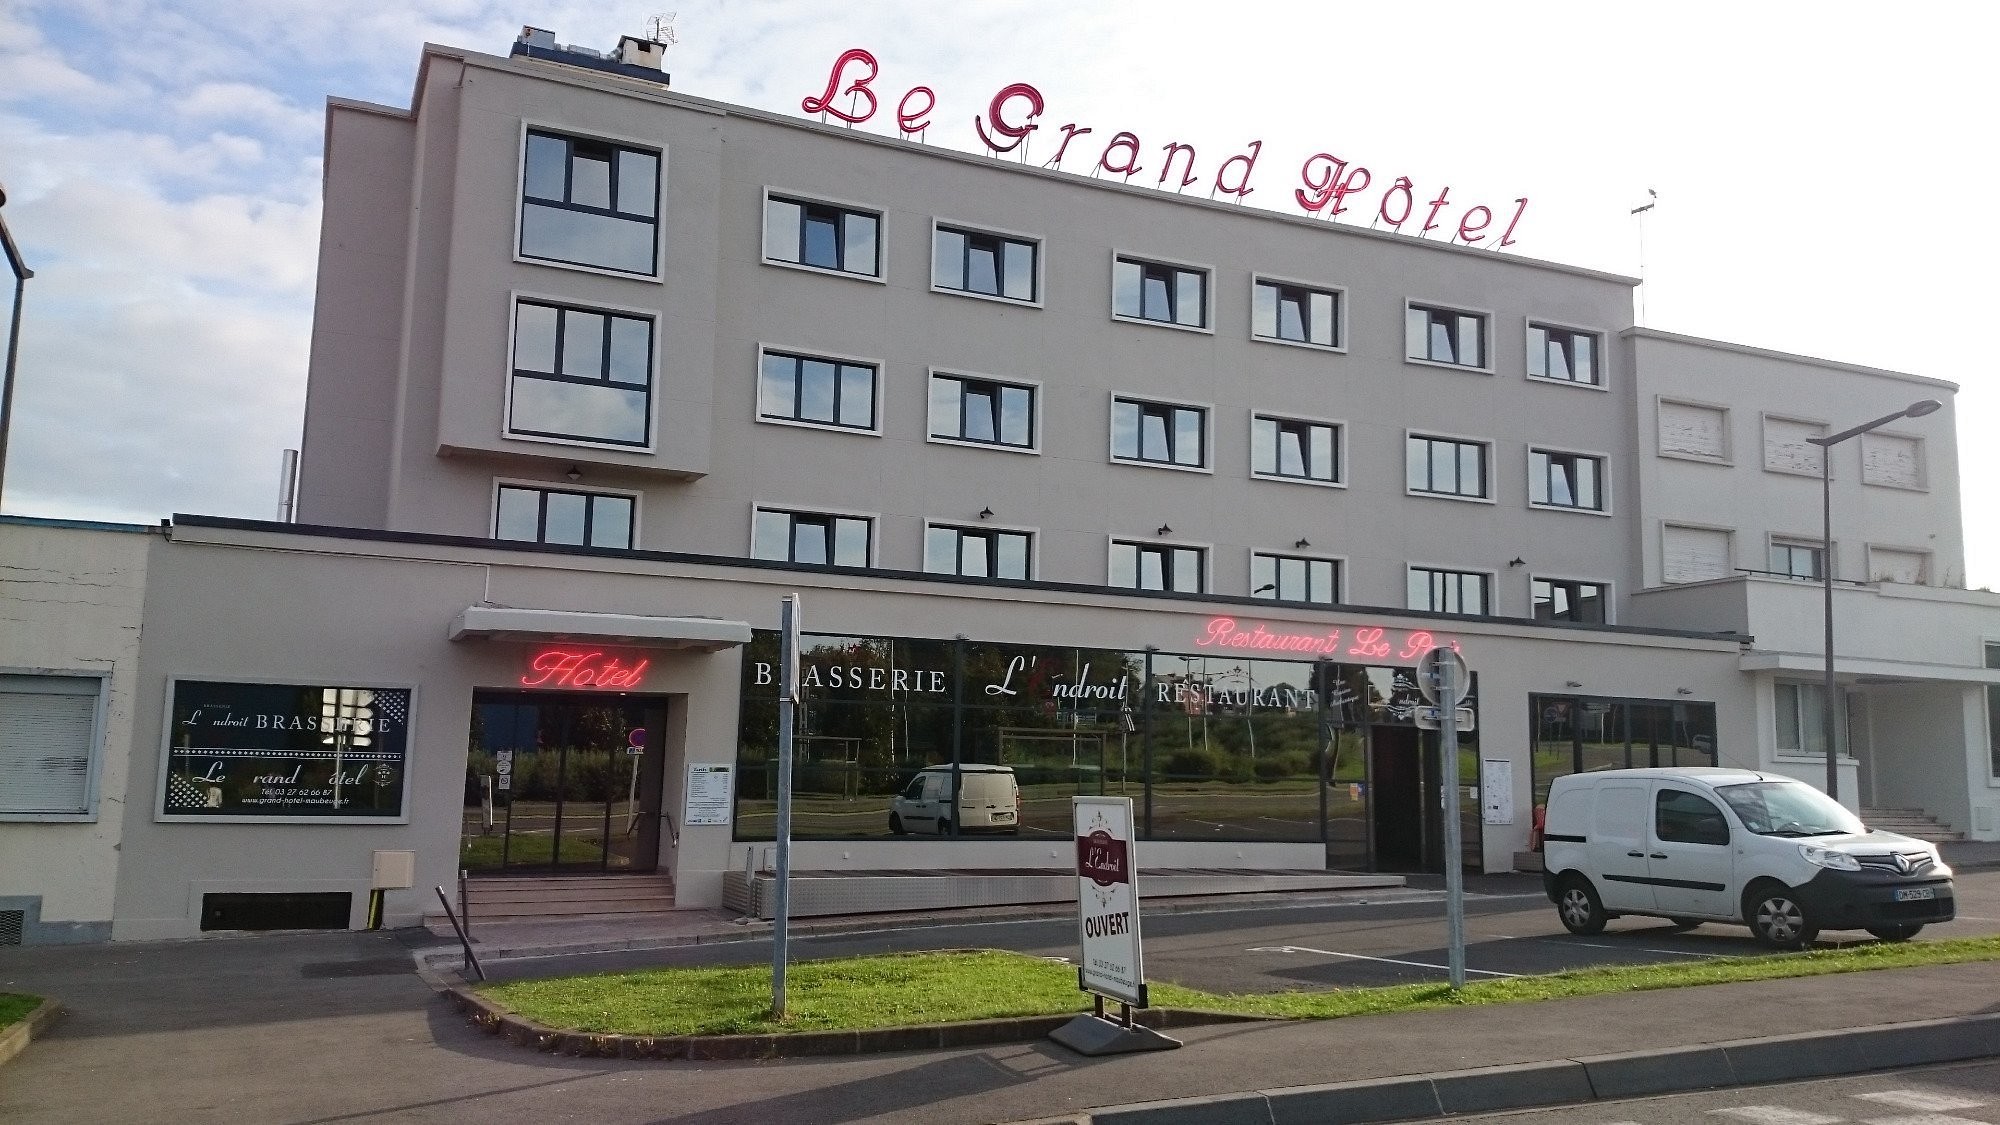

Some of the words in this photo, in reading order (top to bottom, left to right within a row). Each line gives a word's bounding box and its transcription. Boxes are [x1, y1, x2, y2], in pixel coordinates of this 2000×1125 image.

[801, 48, 936, 134] Le
[975, 82, 1263, 197] Grand
[1295, 152, 1528, 247] Hôtel
[1196, 617, 1339, 653] Restaurant
[1349, 628, 1390, 656] Le
[521, 651, 648, 688] Hotel
[753, 662, 946, 693] BASSERIE
[1157, 682, 1316, 709] RESTAURANT
[191, 760, 226, 783] Le
[252, 764, 301, 784] rand
[286, 788, 298, 796] 27
[298, 788, 309, 796] 62
[310, 788, 321, 796] 66
[322, 788, 333, 796] 87
[1085, 911, 1130, 939] OUVERT
